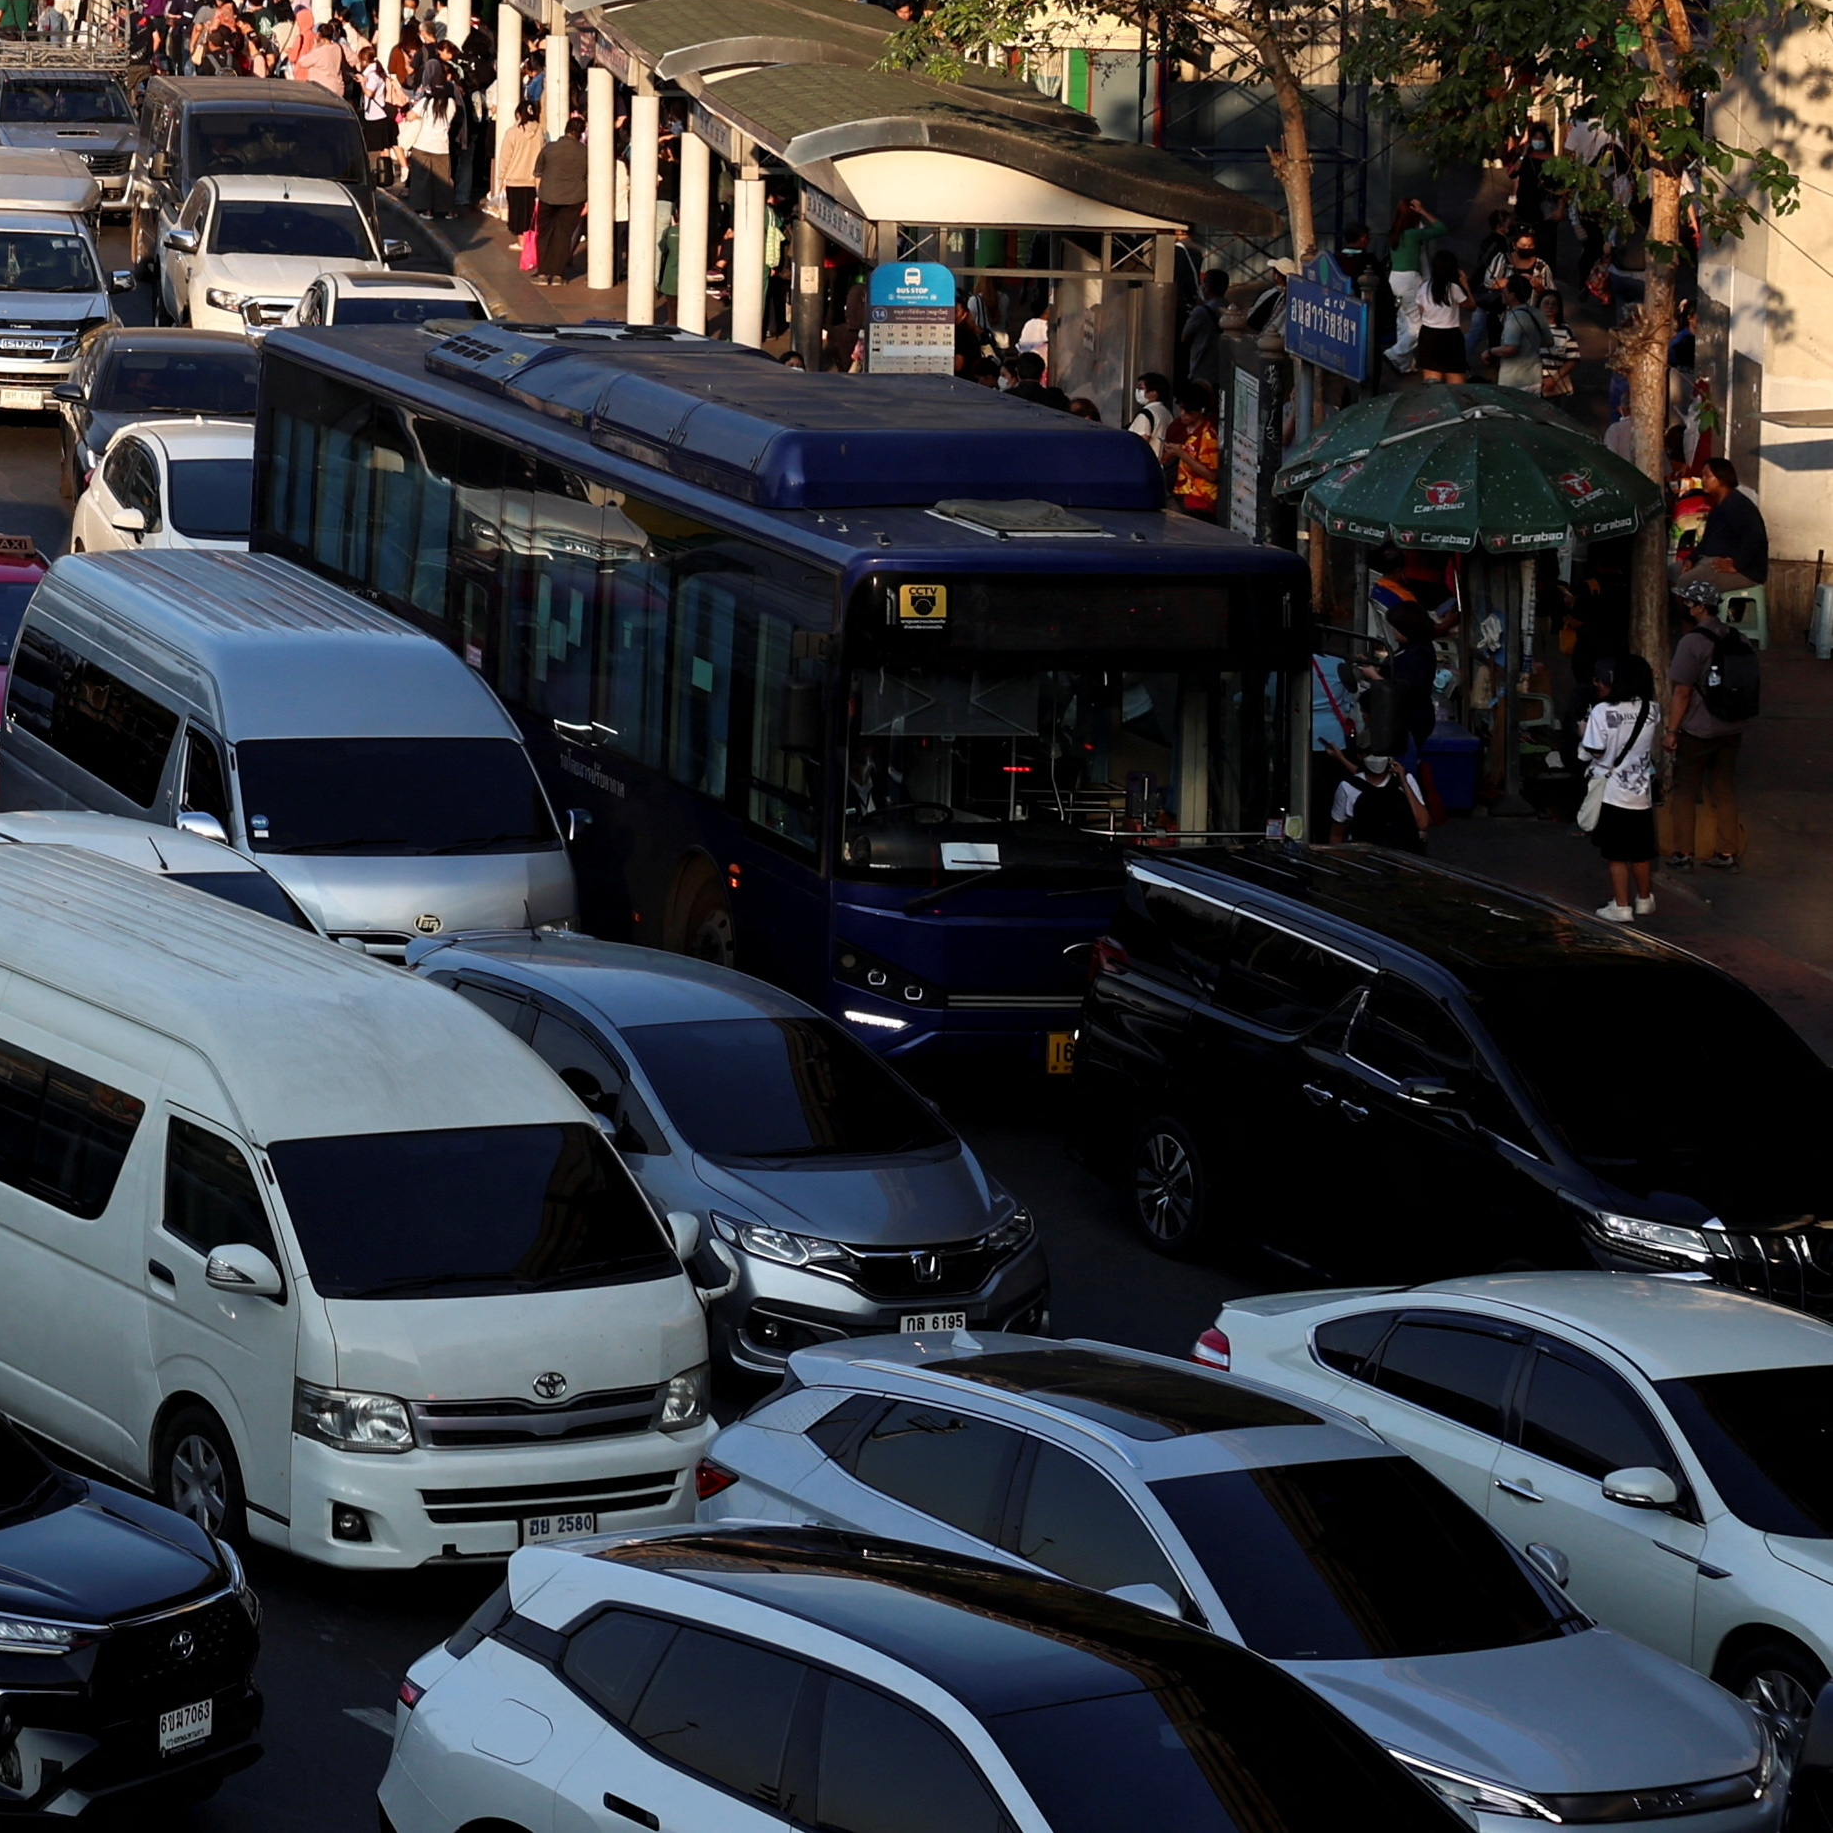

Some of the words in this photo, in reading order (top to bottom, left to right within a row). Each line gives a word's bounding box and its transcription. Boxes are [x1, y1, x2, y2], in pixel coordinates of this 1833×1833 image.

[3, 339, 43, 350] ISUZU
[1414, 501, 1465, 514] Carabao
[1348, 522, 1384, 537] Carabao
[1593, 518, 1632, 533] Carabao
[1421, 532, 1471, 546] Carabao
[1512, 530, 1564, 544] Carabao
[908, 587, 937, 595] CCTV
[907, 1317, 925, 1331] กล
[932, 1313, 962, 1330] 6195
[558, 1515, 592, 1533] 2580
[184, 1701, 210, 1727] 7063
